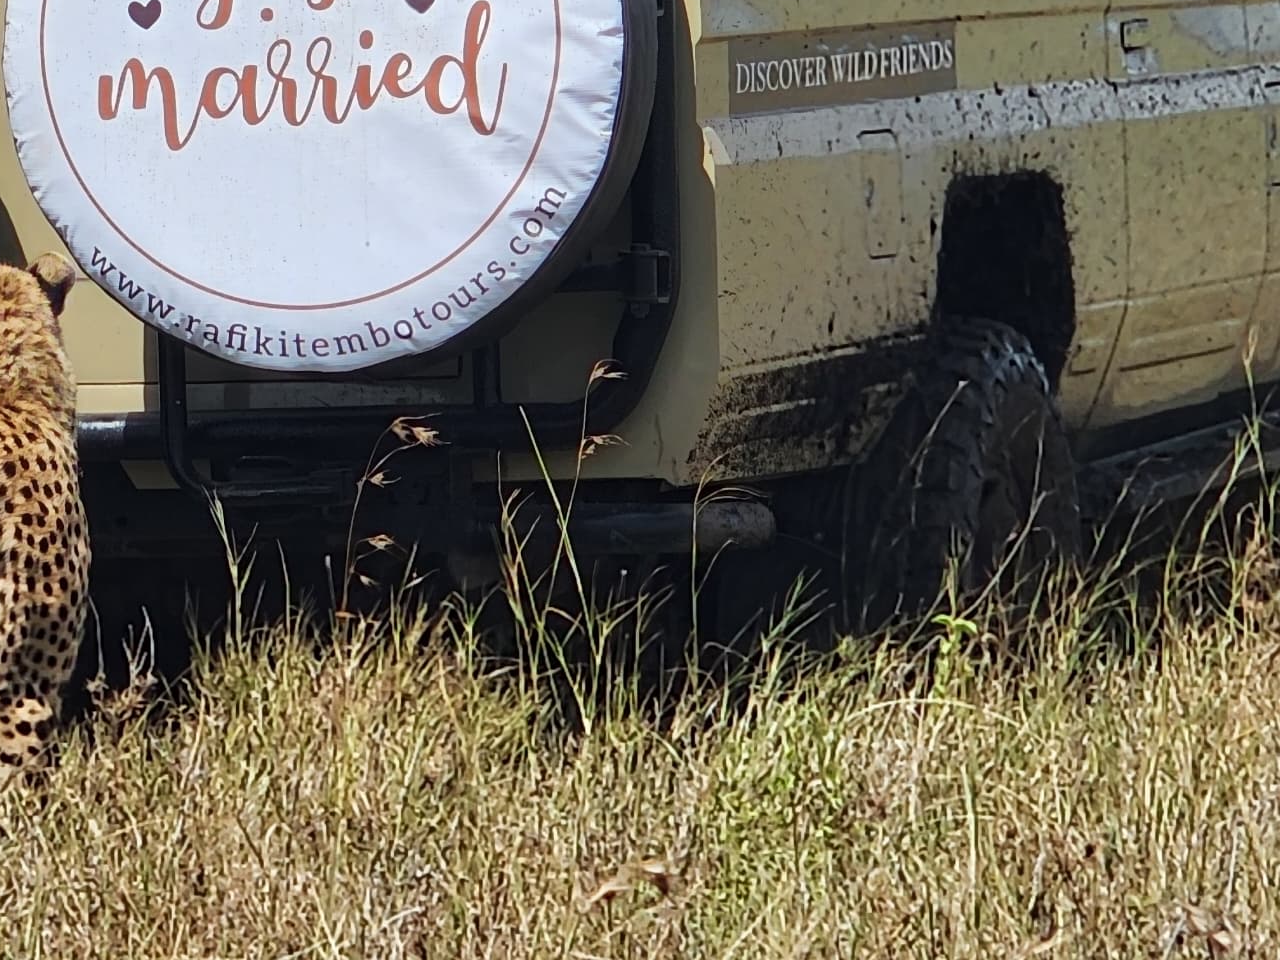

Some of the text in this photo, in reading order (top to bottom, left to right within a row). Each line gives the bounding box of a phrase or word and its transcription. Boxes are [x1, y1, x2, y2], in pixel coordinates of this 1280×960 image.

[97, 0, 507, 152] married
[735, 55, 827, 94] DISCOVER
[90, 184, 567, 359] www.rafikitembotours.com
